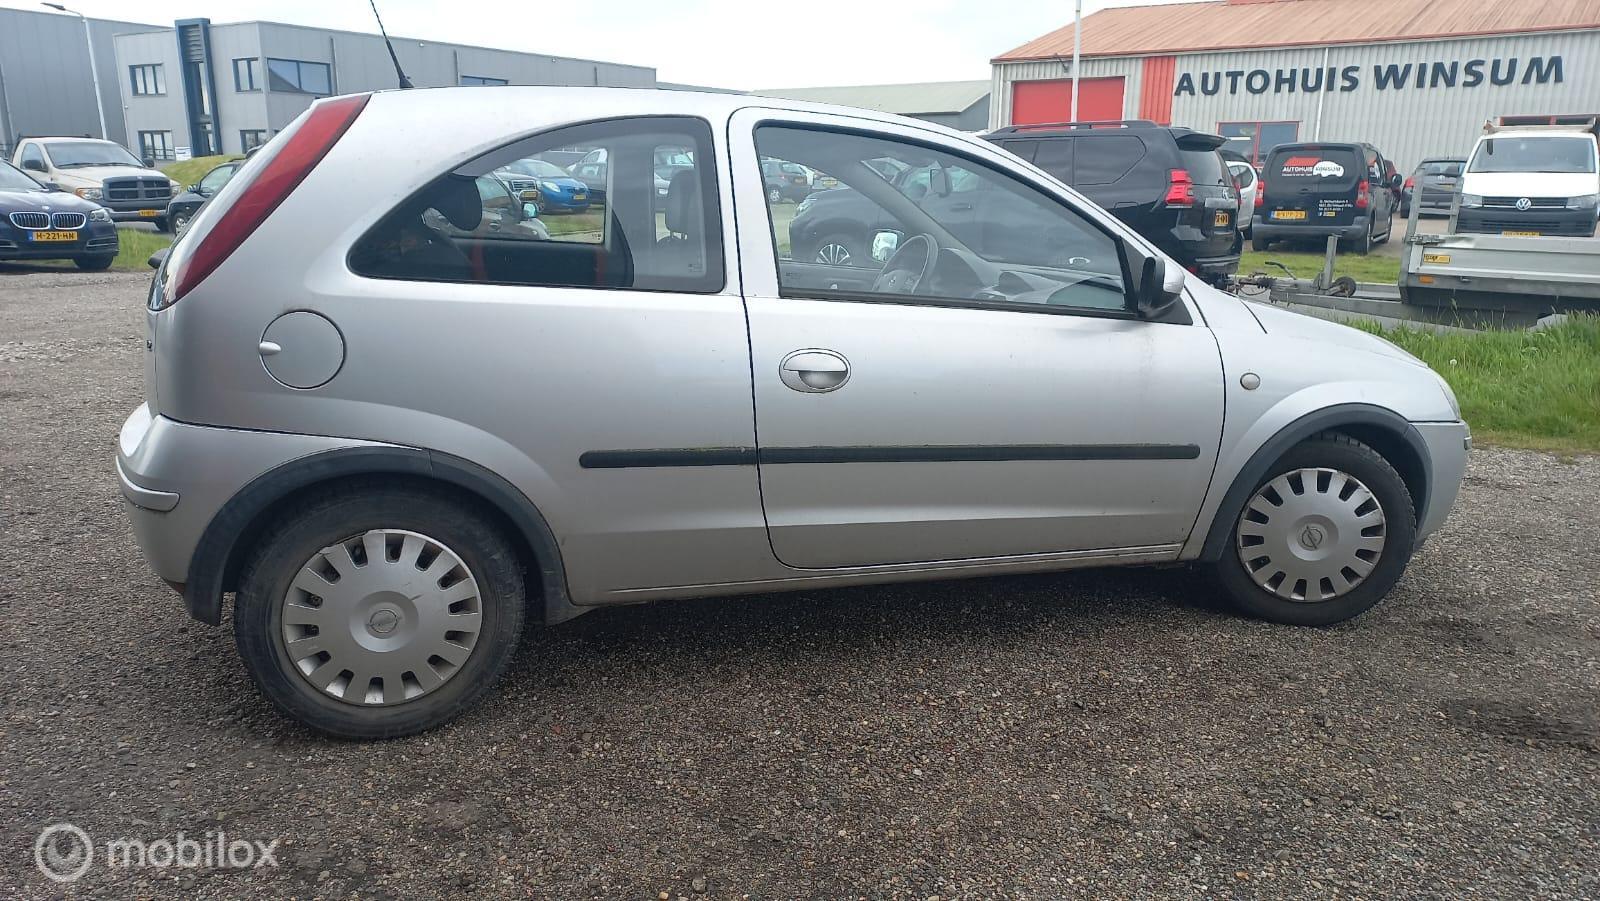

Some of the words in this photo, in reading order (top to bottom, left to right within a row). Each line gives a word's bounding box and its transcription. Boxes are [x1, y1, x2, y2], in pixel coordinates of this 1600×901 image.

[1174, 65, 1361, 96] AUTOHUIS
[1373, 55, 1564, 90] WINSUM
[36, 232, 75, 240] H-221-HN
